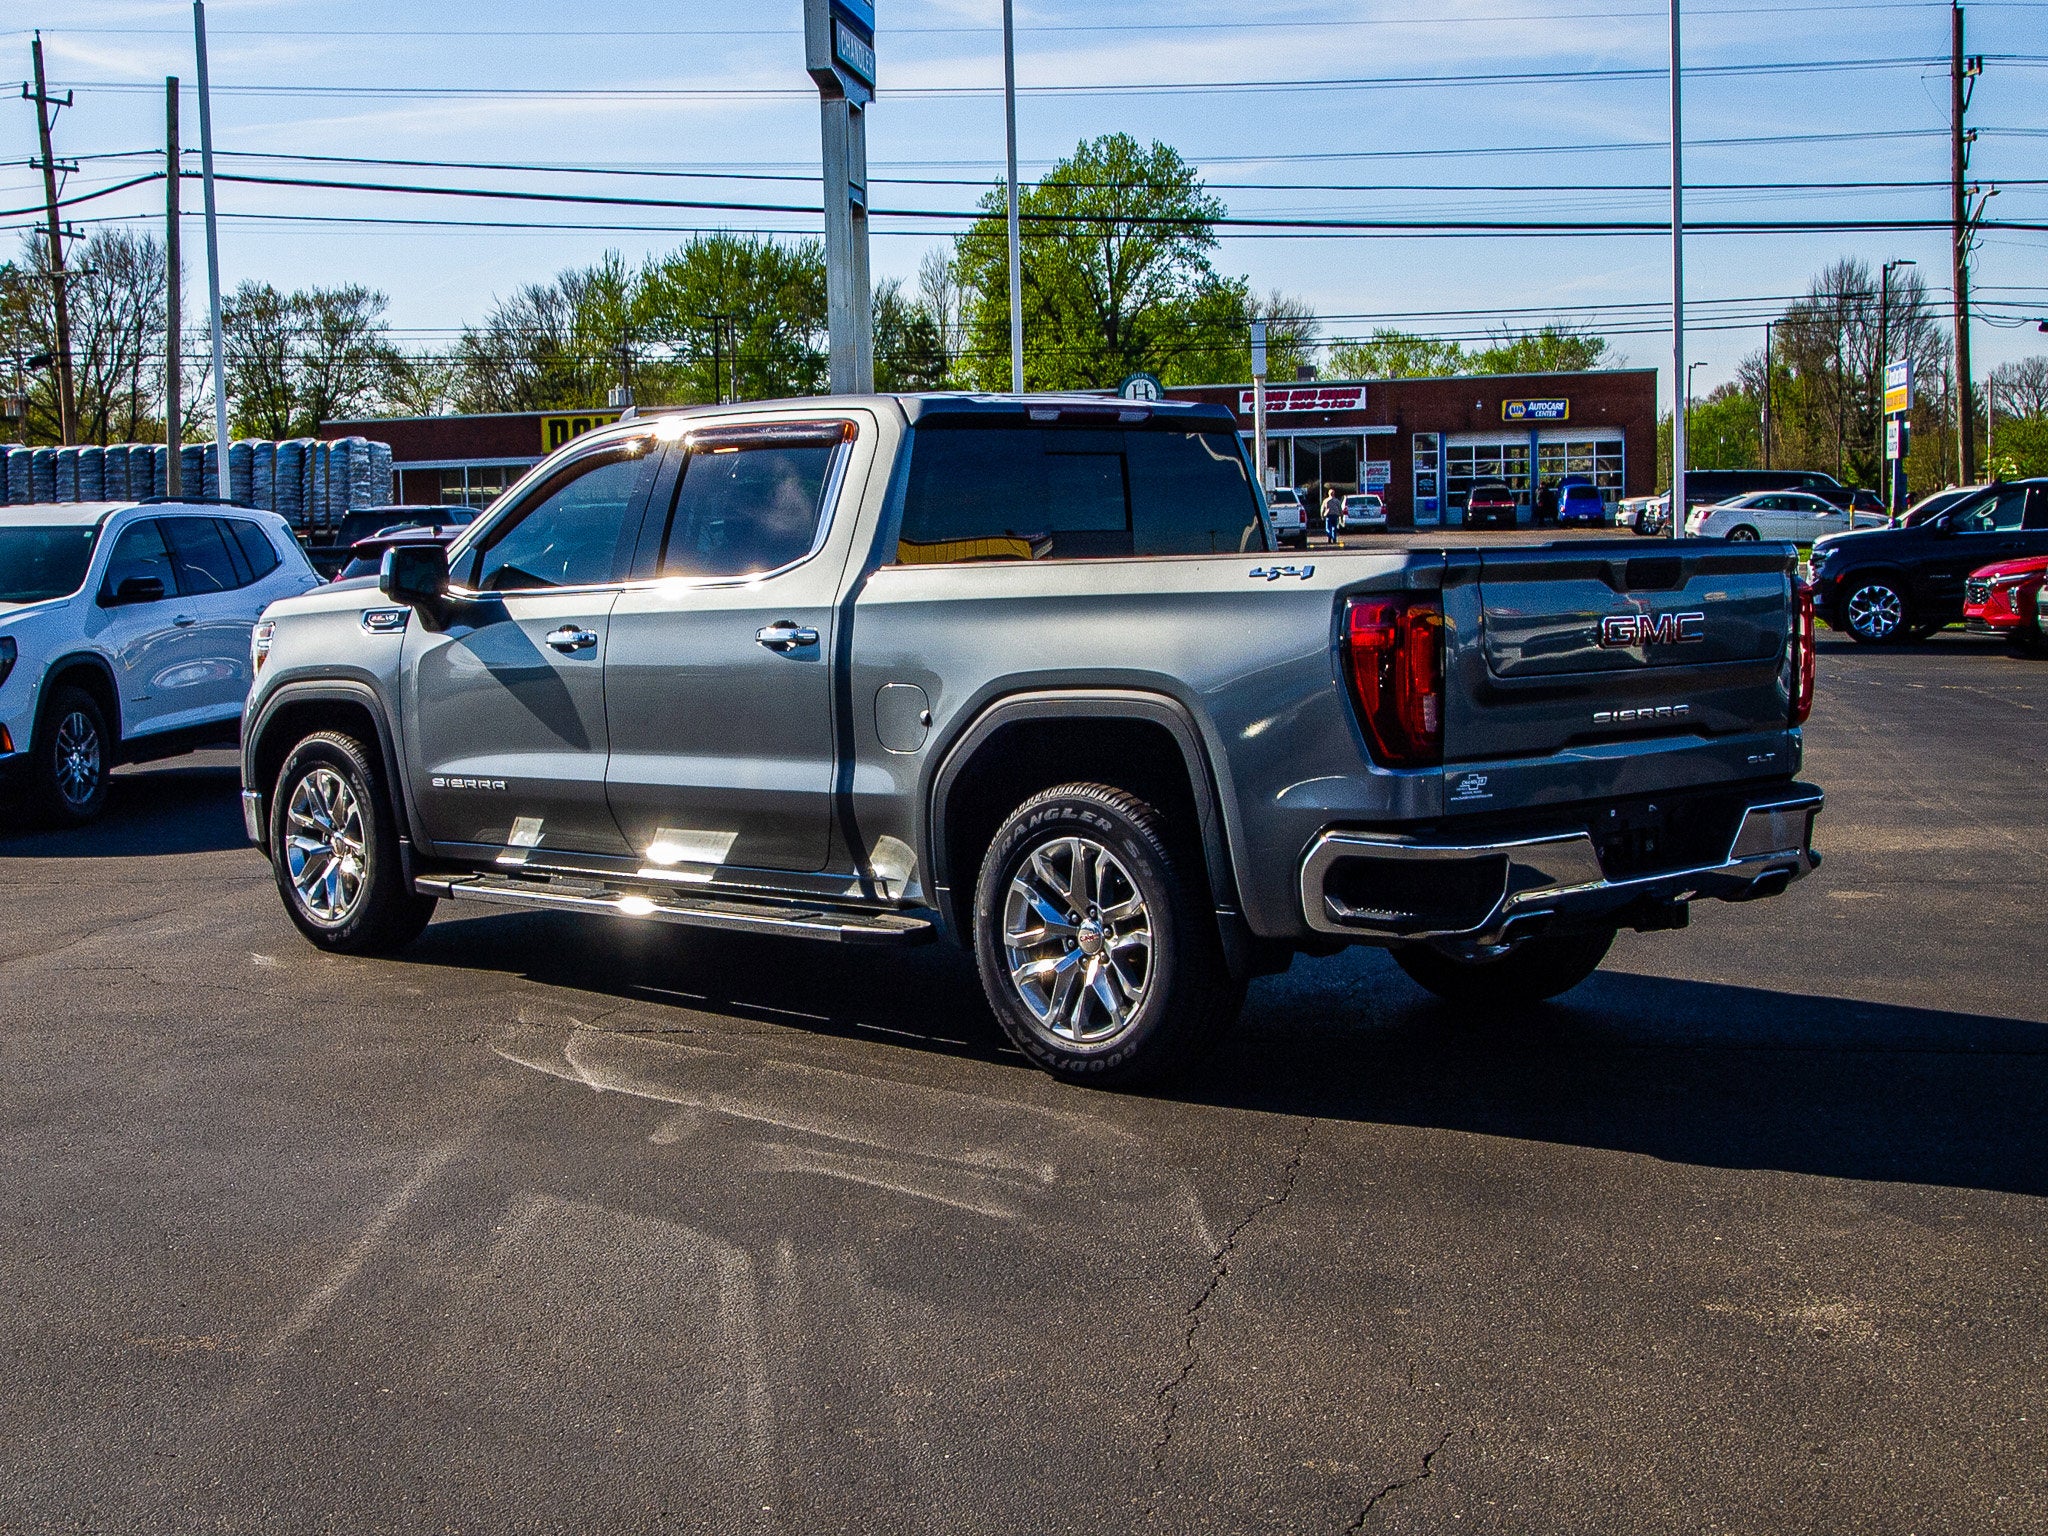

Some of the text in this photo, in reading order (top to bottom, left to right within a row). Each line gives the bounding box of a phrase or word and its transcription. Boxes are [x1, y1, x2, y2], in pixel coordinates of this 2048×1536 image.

[840, 30, 873, 76] CHANDLER
[1601, 612, 1705, 648] GMC
[1593, 704, 1690, 723] SIERRA
[1747, 752, 1776, 763] SLT
[431, 777, 506, 790] SIERRA
